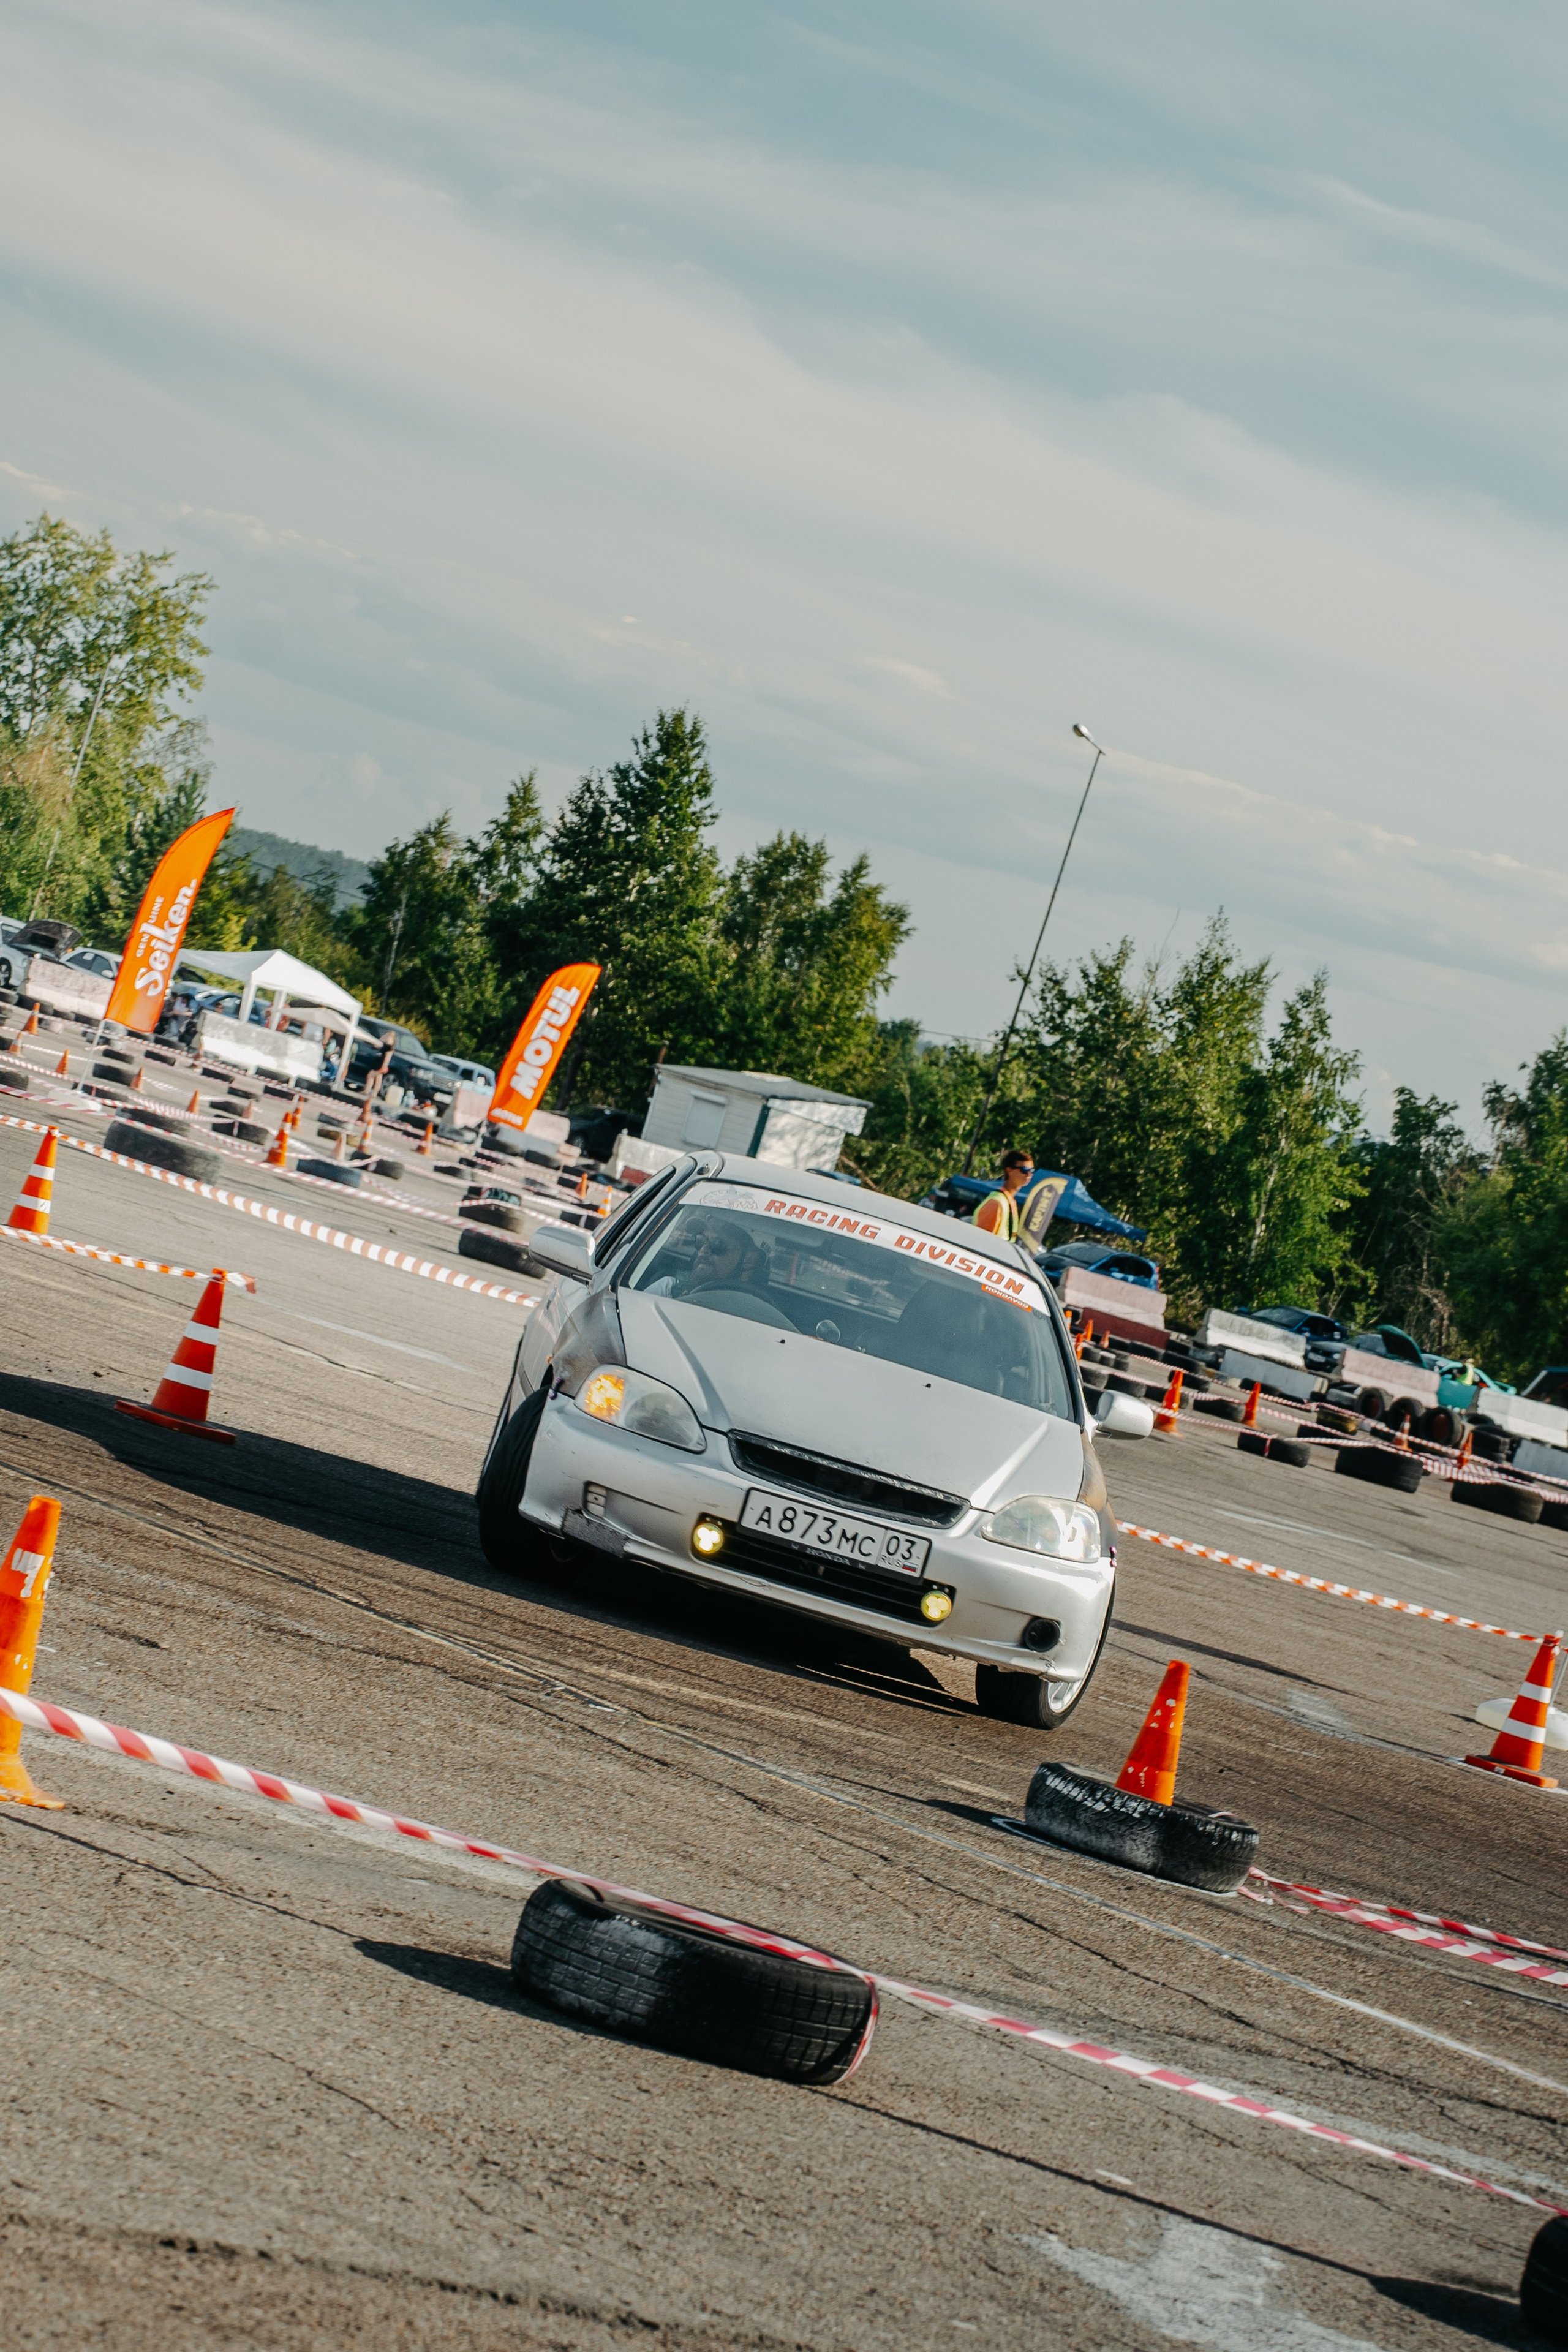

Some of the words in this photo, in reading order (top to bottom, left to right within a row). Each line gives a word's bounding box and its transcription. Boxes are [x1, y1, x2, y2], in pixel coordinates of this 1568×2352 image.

[510, 985, 581, 1101] MOTUL
[764, 1199, 881, 1240] RACING
[894, 1235, 1025, 1295] DIVISION
[805, 1547, 851, 1566] HONDA
[886, 1535, 916, 1560] 03
[881, 1555, 903, 1568] RUS
